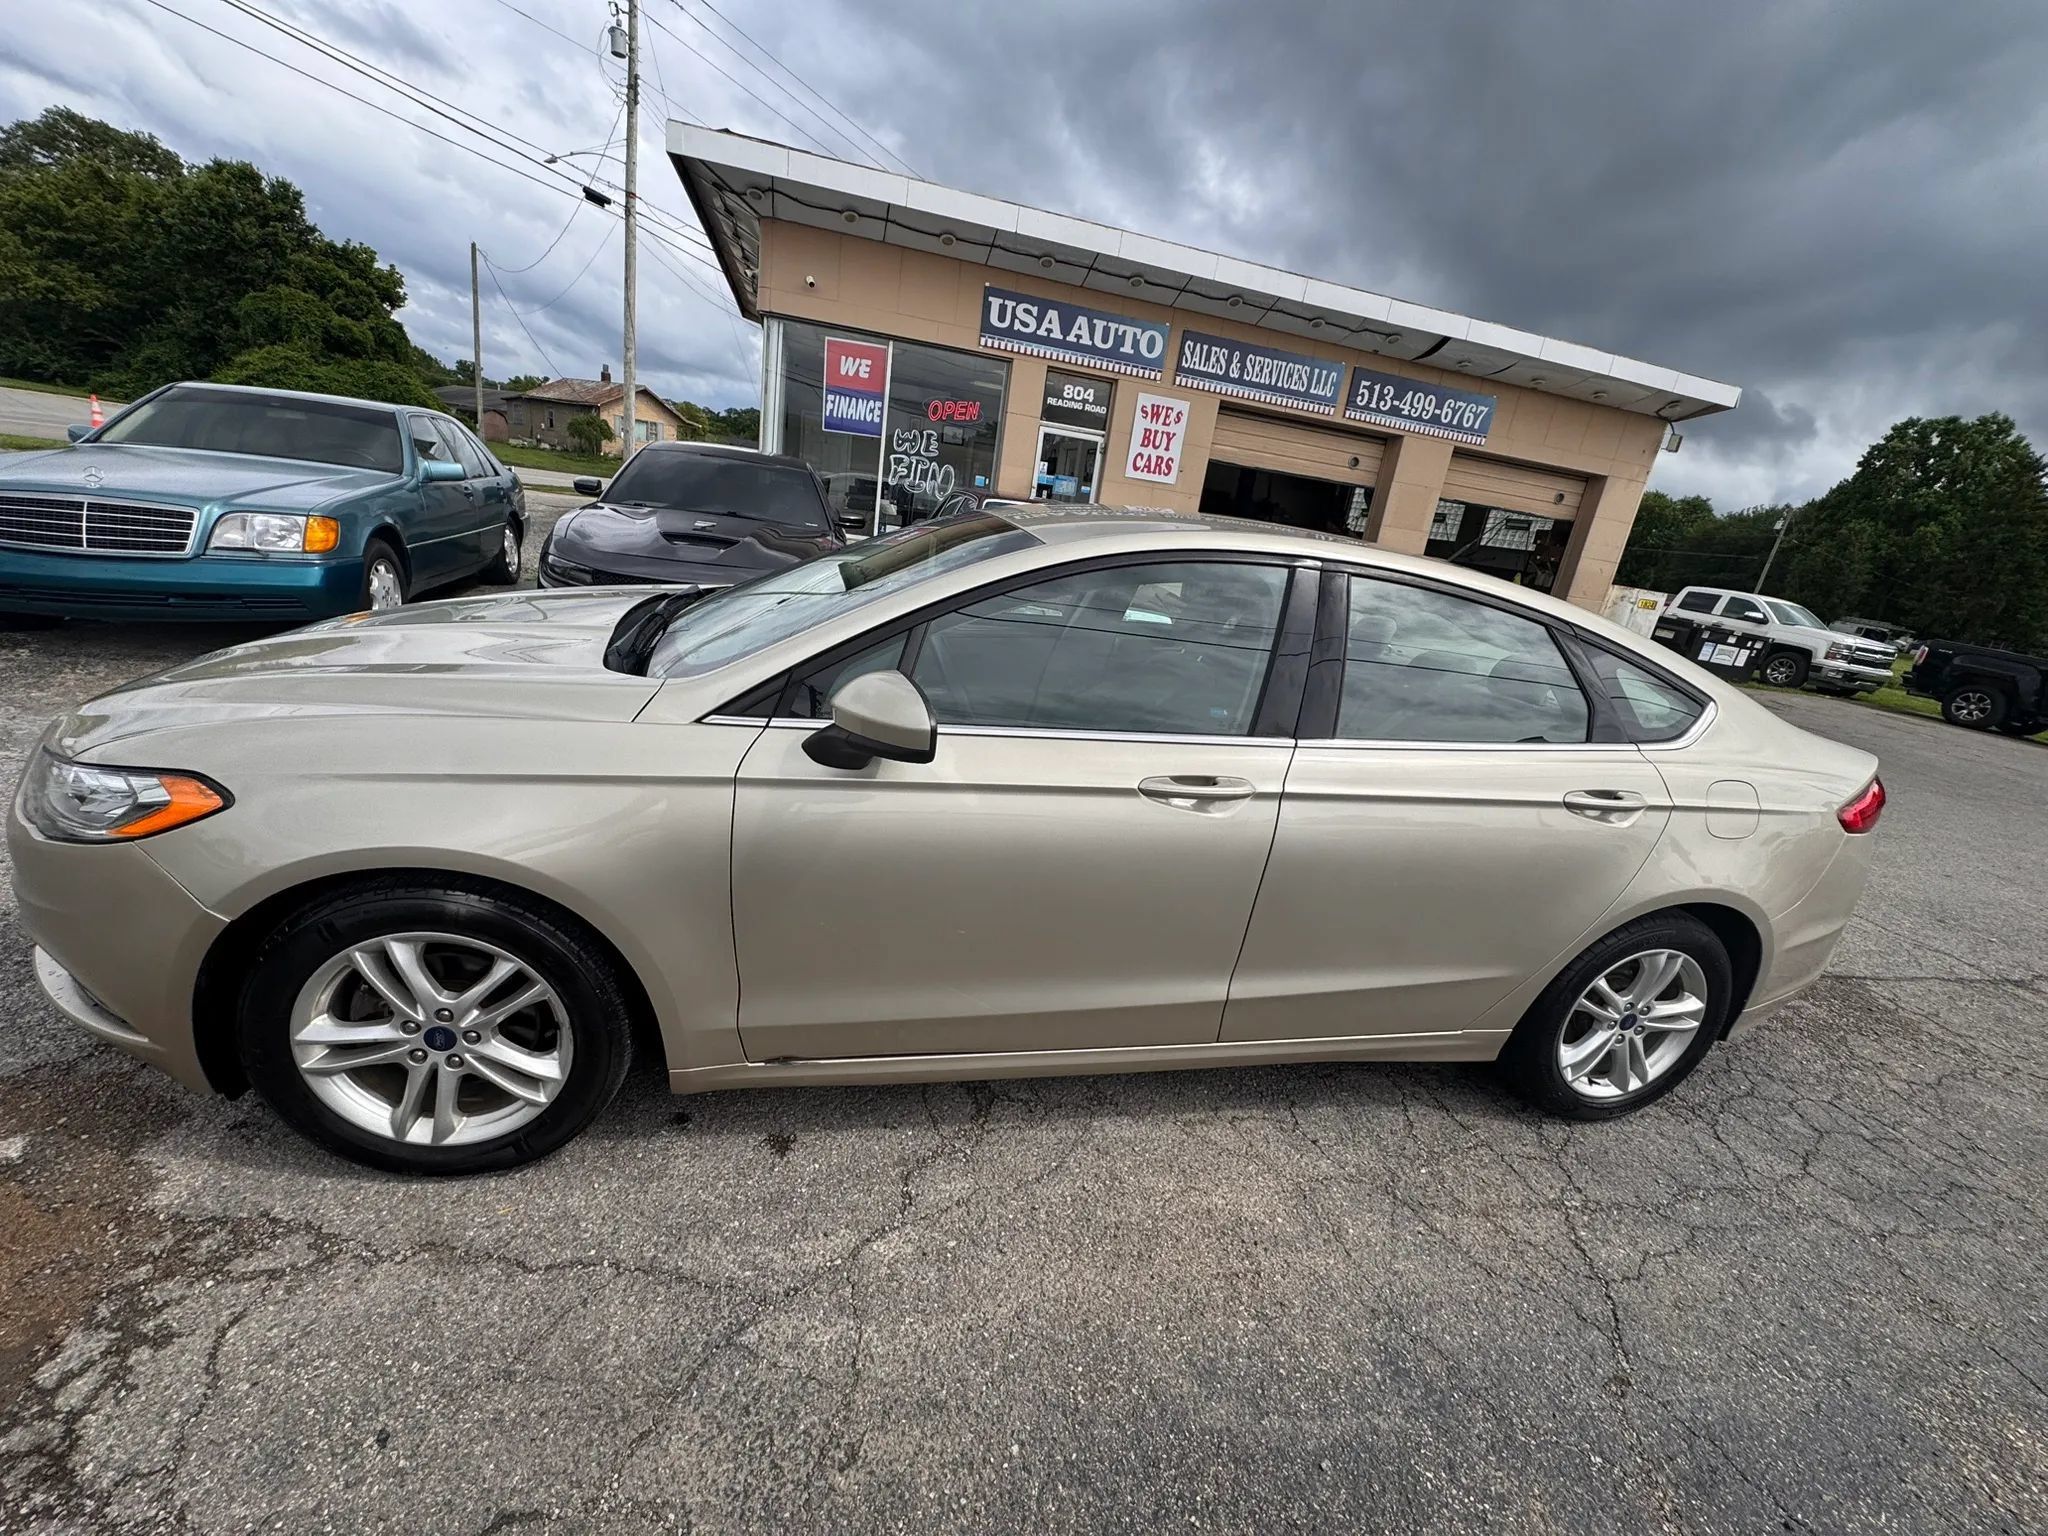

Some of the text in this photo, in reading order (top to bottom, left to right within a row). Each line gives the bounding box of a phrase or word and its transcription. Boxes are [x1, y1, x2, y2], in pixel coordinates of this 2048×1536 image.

[988, 296, 1164, 359] USA AUTO
[840, 355, 872, 379] WE
[1182, 340, 1338, 398] SALES & SERVICES LLC
[1047, 397, 1107, 415] READING ROAD
[1063, 384, 1095, 403] 804
[1356, 380, 1489, 430] 513-499-6767
[826, 394, 882, 423] FINANCE
[928, 400, 981, 421] OPEN
[893, 428, 939, 456] WE
[1140, 428, 1176, 451] BUY
[1132, 452, 1174, 477] CARS
